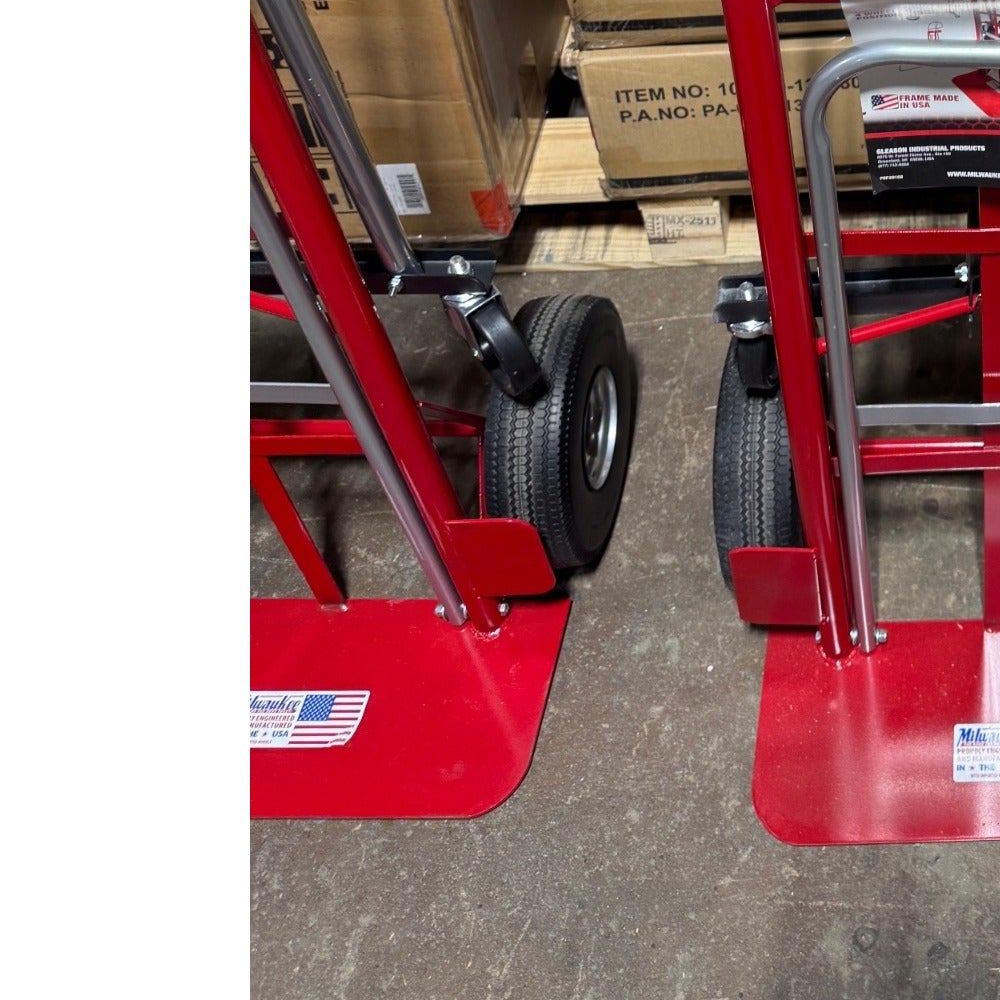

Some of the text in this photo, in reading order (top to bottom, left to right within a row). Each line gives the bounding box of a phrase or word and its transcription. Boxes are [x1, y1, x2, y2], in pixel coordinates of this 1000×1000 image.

[615, 87, 666, 103] ITEM
[672, 85, 710, 99] NO:
[899, 93, 960, 102] FRAME MADE
[911, 101, 931, 109] USA
[619, 107, 696, 123] P.A.NO:
[876, 144, 986, 154] GLEASON INDUSTRIAL PRODUCTS
